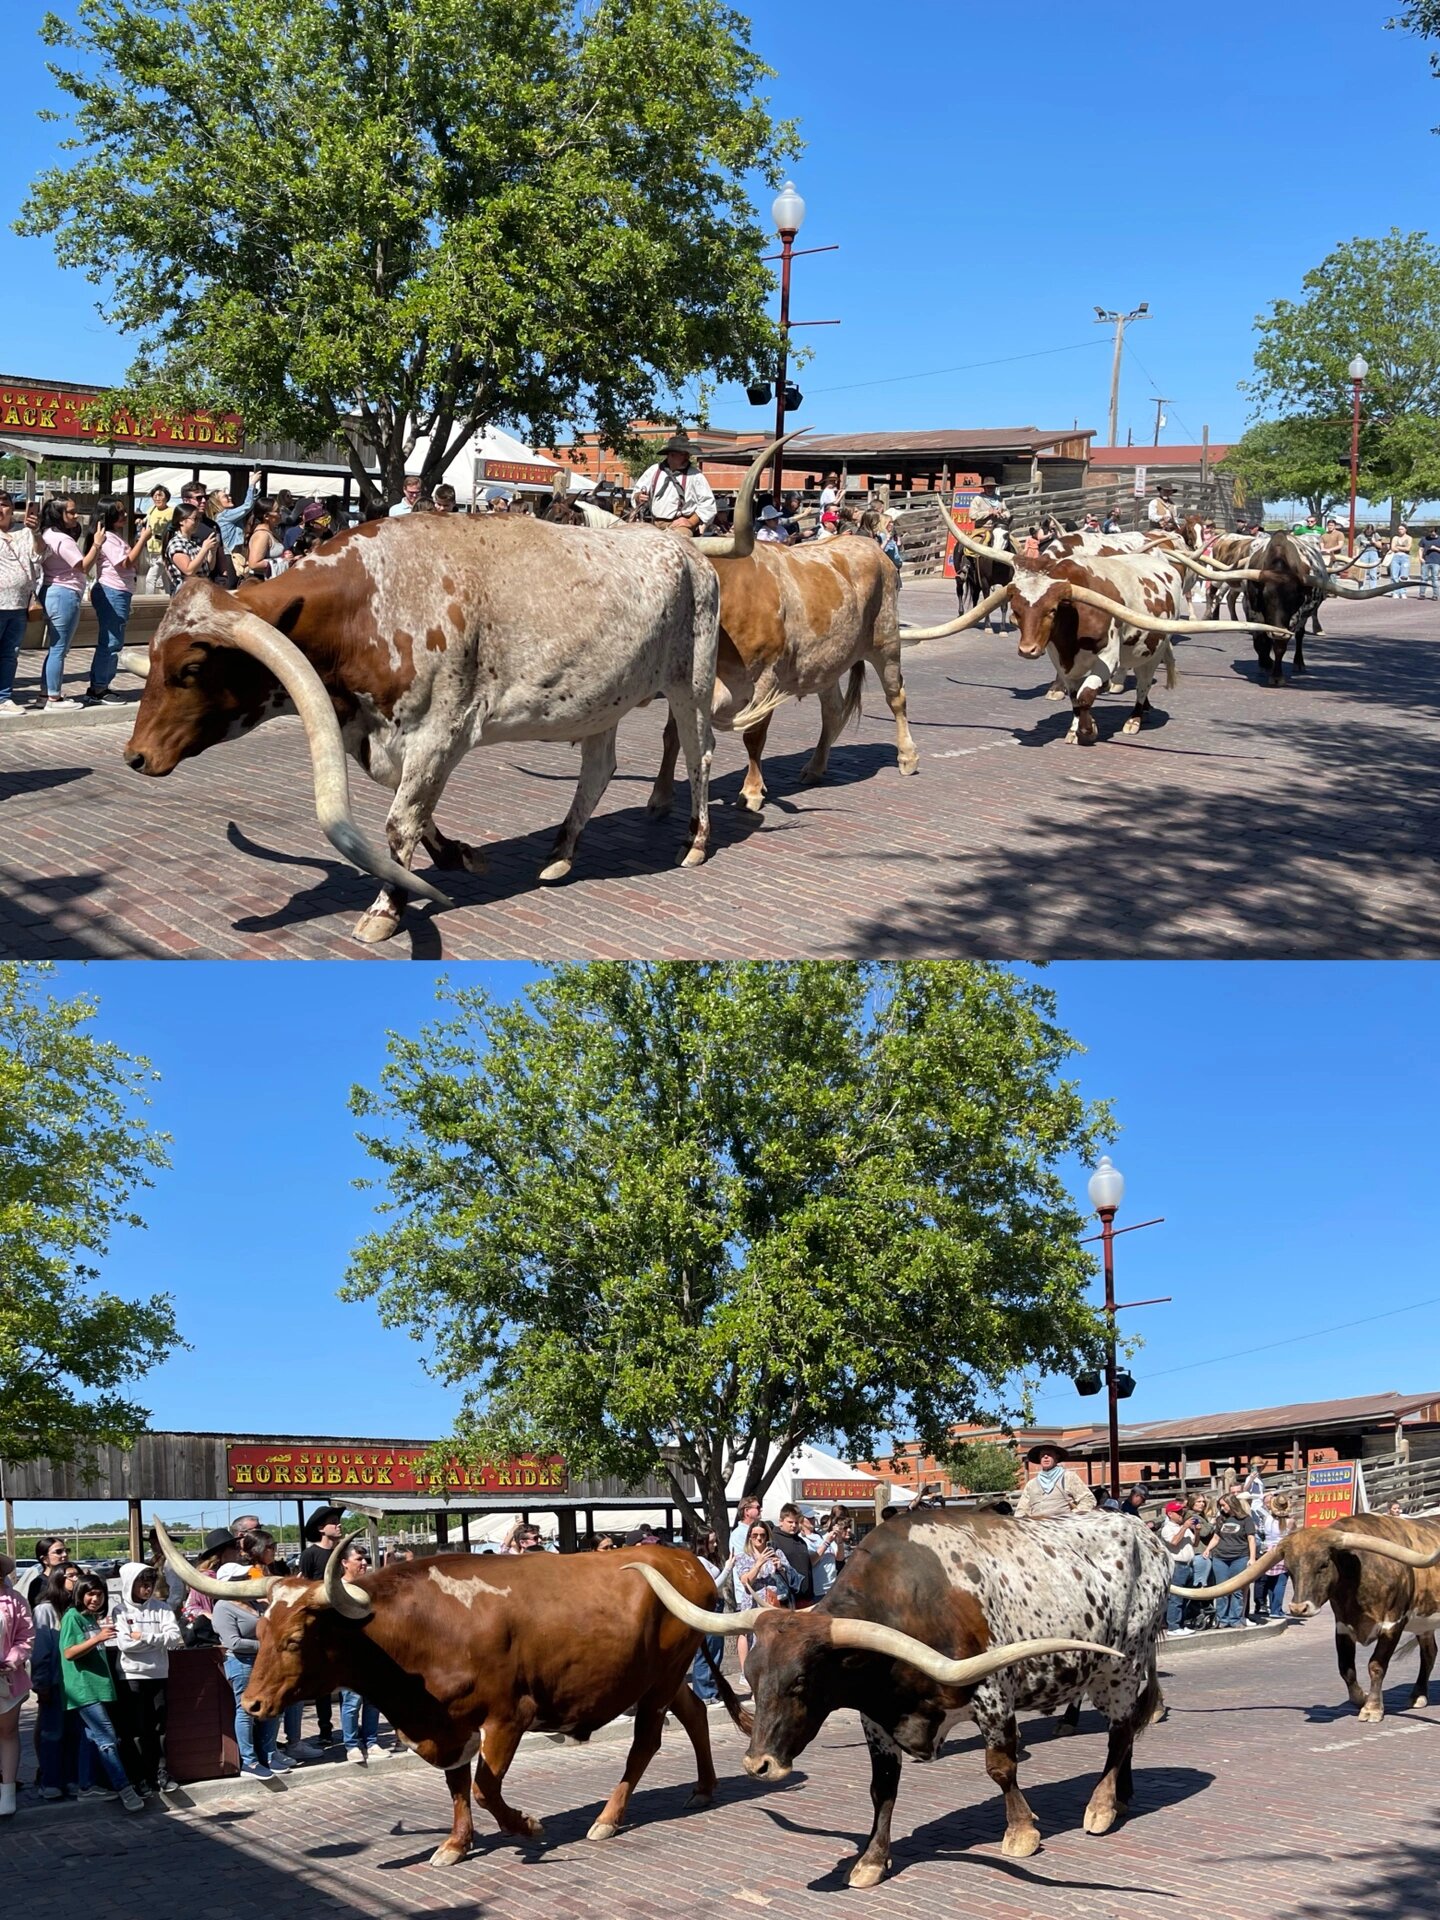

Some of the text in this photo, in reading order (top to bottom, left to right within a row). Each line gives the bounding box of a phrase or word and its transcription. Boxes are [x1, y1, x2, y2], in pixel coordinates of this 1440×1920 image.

[0, 405, 57, 428] ACK
[170, 423, 237, 445] RIDES
[236, 1464, 393, 1485] HORSEBACK
[498, 1467, 564, 1487] RIDES
[805, 1487, 853, 1496] PETTING
[1308, 1489, 1350, 1503] PETTING
[1319, 1509, 1338, 1520] ZOO
